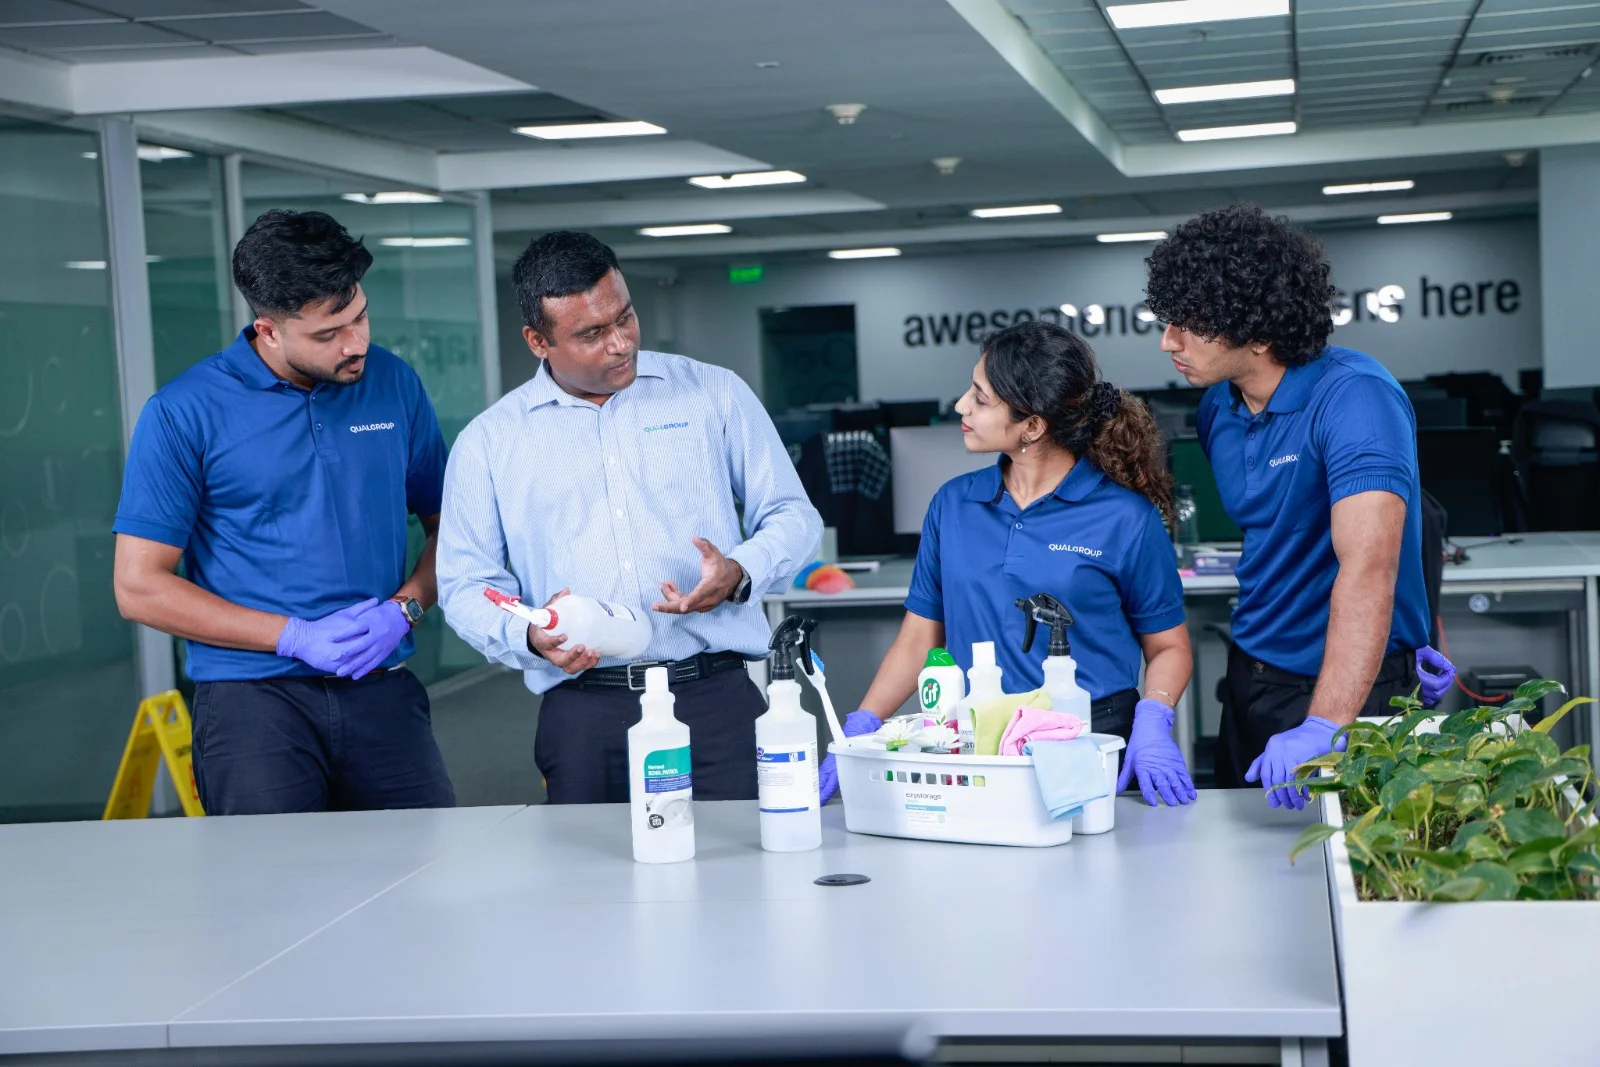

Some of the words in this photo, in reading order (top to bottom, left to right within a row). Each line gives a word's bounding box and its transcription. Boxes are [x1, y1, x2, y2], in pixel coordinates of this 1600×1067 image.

[1420, 275, 1521, 319] here
[349, 422, 395, 434] QUALGROUP
[1048, 543, 1102, 557] QUALGROUP
[923, 682, 938, 706] Cif
